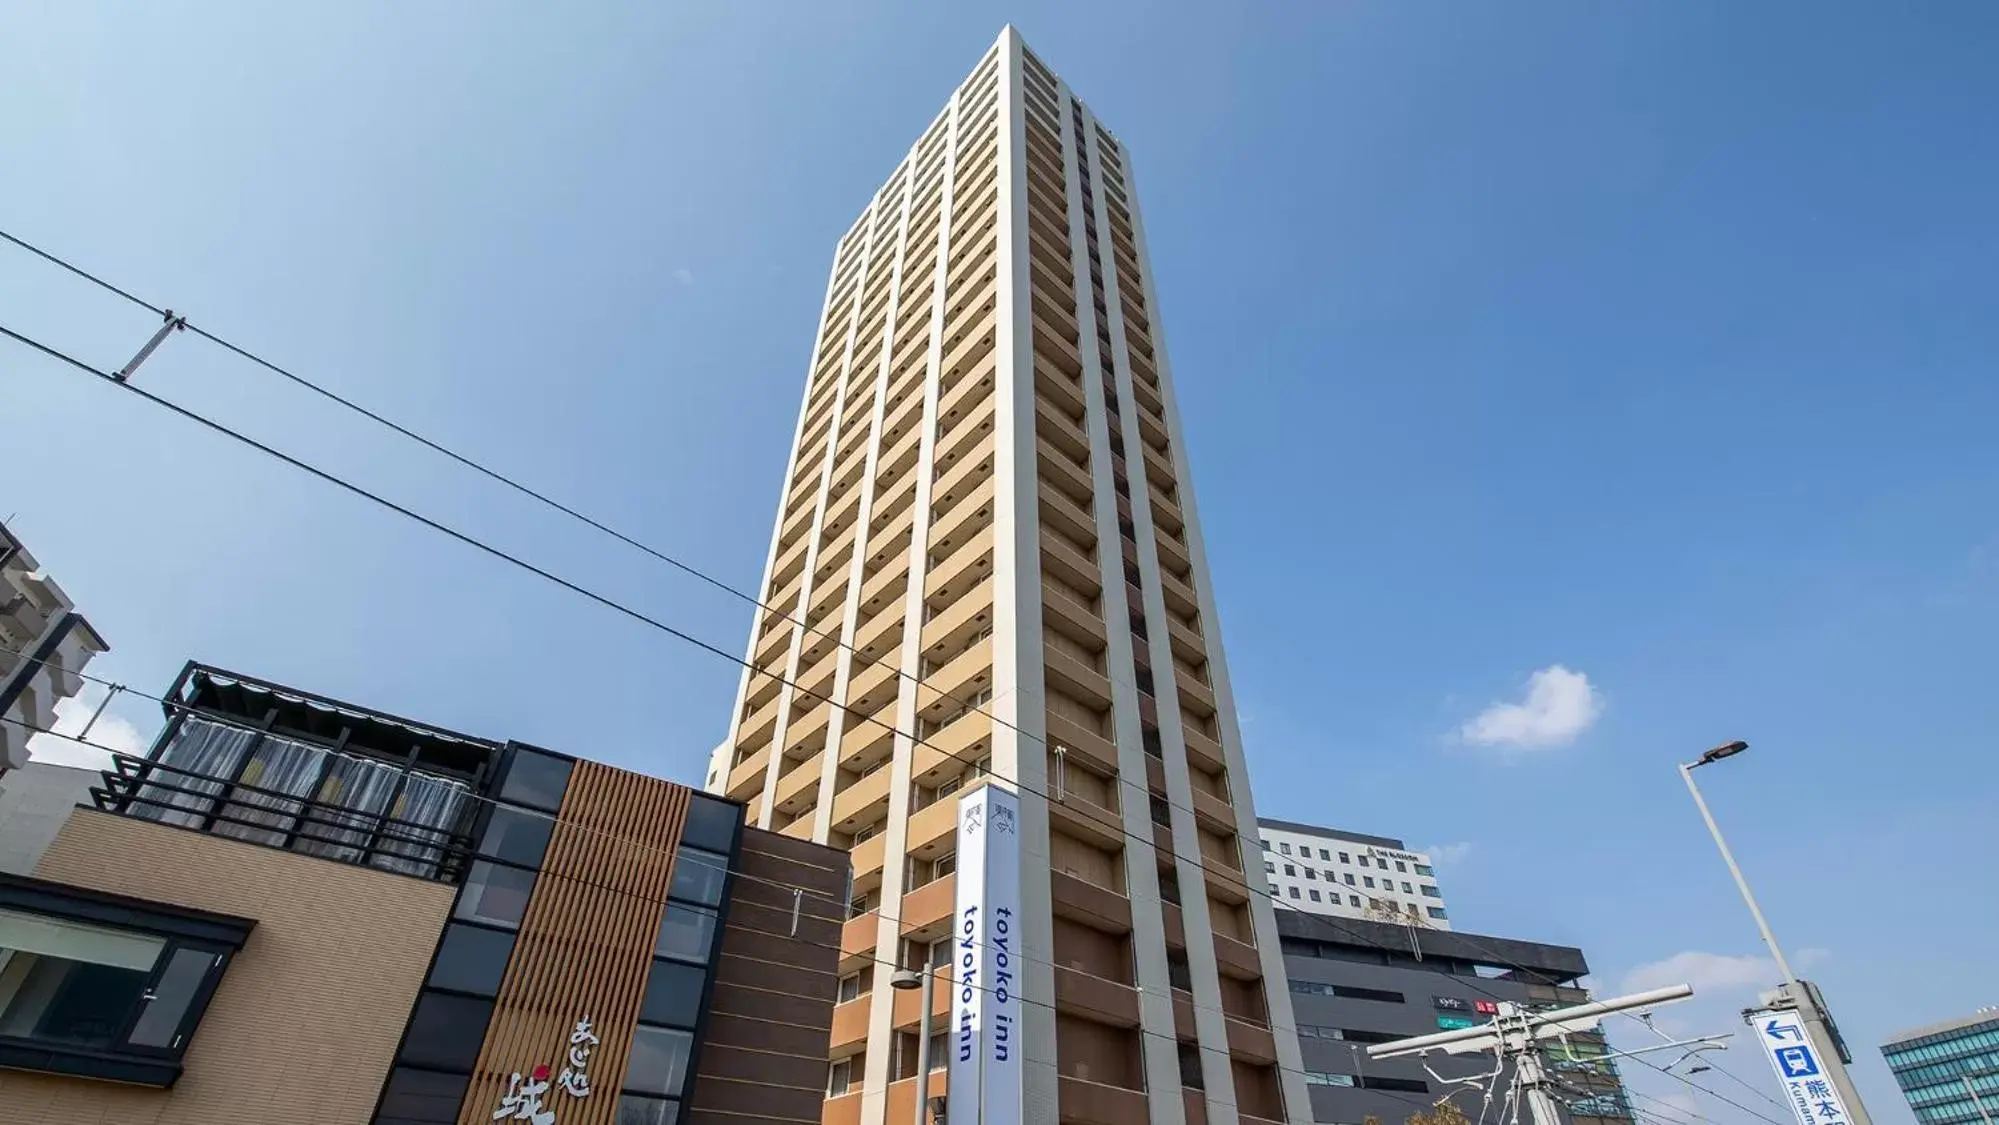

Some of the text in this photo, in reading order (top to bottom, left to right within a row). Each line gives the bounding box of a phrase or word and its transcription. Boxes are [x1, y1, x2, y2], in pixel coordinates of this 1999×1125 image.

[558, 1014, 600, 1097] あじ処
[960, 905, 978, 1062] toyoko inn
[993, 905, 1013, 1062] toyoko inn
